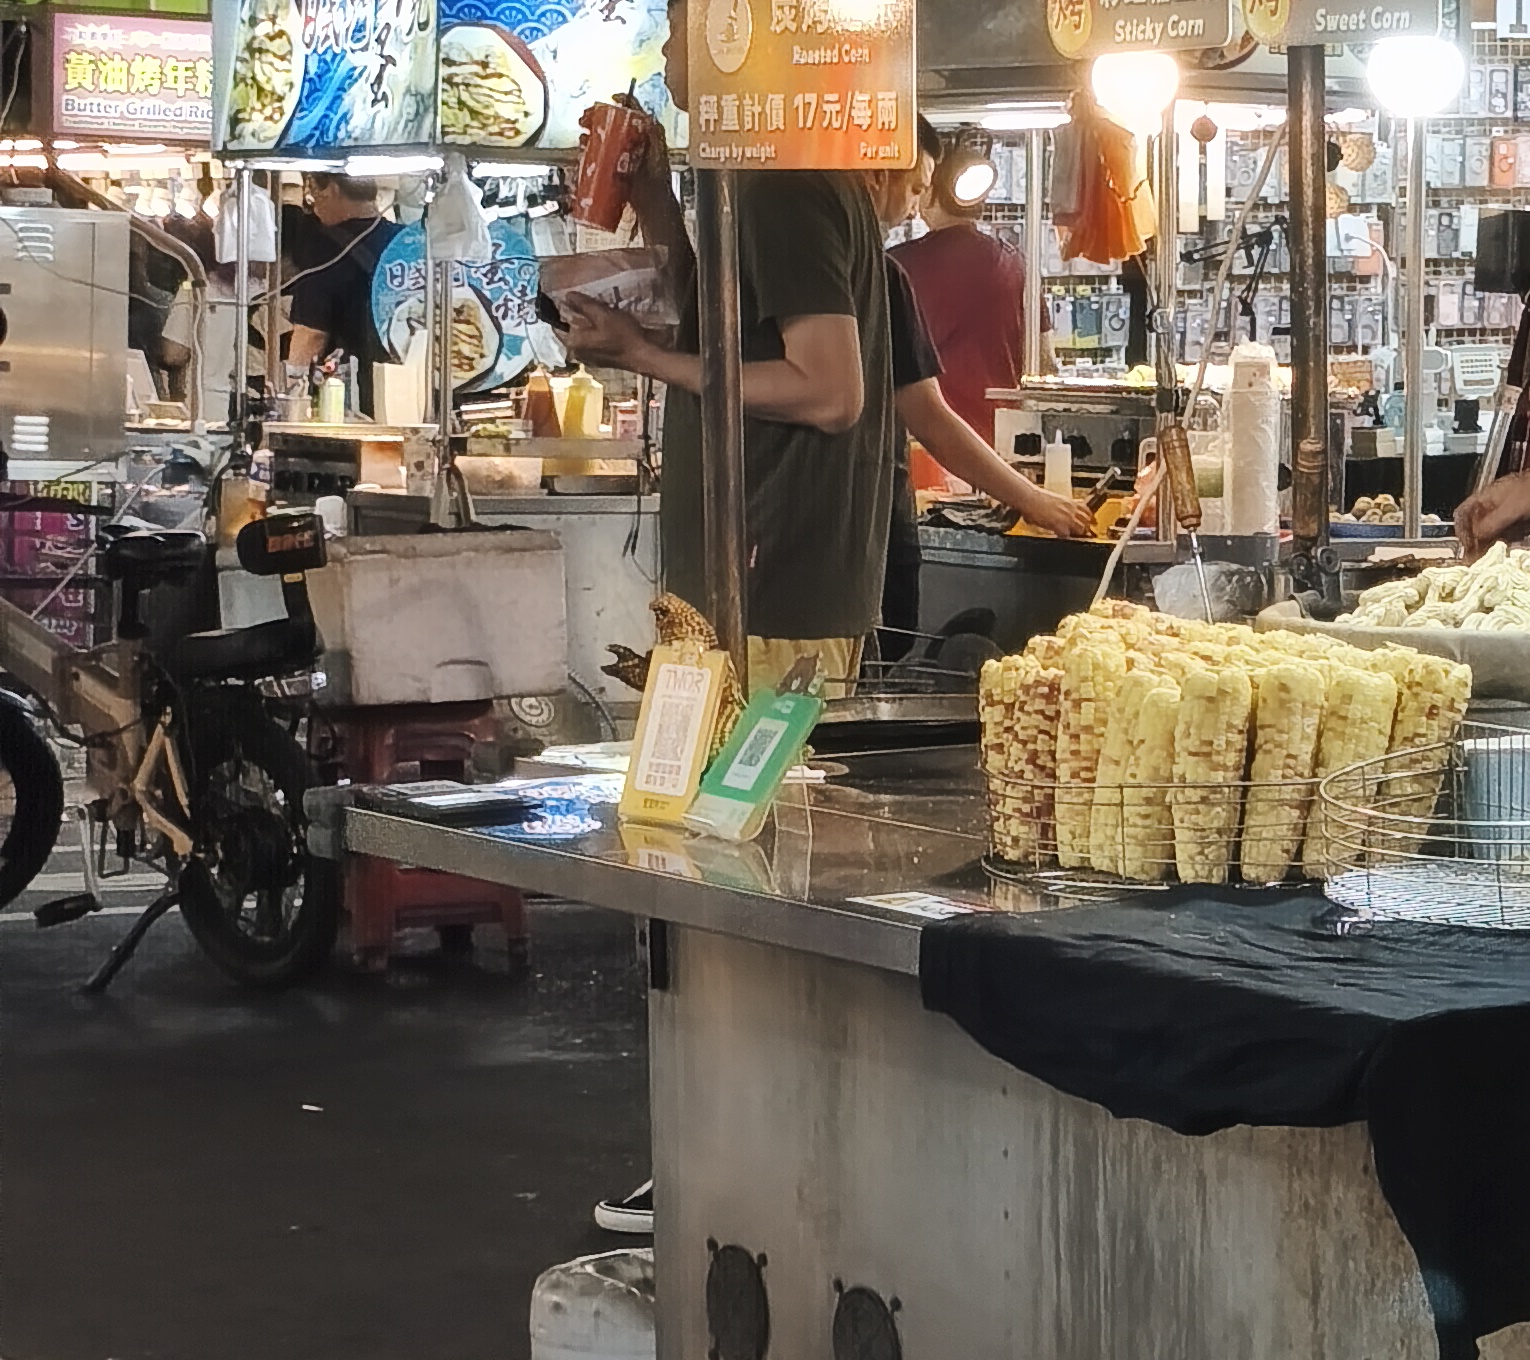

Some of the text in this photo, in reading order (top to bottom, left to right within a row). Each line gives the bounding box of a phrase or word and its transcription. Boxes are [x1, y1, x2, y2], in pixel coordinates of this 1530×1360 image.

[1114, 14, 1203, 45] Sticky Corn
[1315, 6, 1410, 32] Sweet Corn
[64, 98, 213, 119] Butter Grilled Ric
[699, 92, 785, 133] 秤重計價
